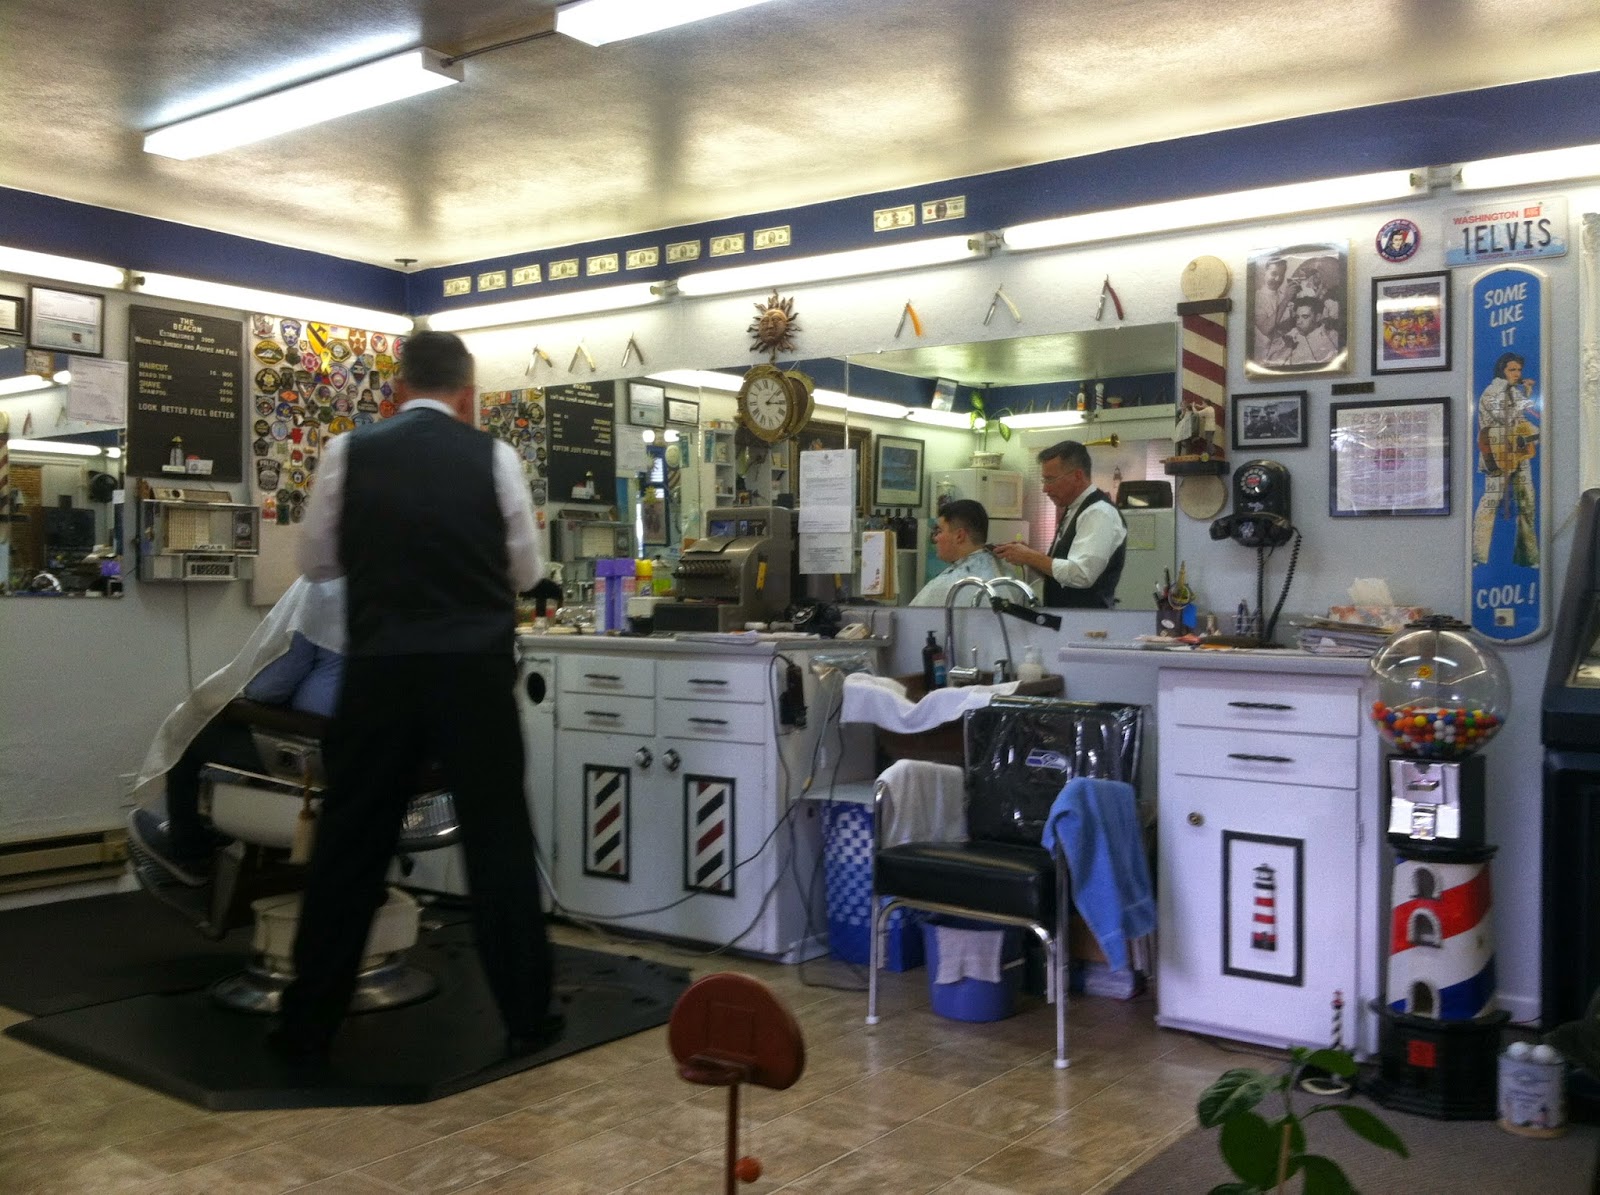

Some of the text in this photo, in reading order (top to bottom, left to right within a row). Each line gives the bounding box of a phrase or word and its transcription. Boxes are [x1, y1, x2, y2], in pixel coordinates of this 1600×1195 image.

[1453, 211, 1518, 225] WASHINGTON
[1462, 218, 1551, 255] 1ELVIS
[1484, 282, 1528, 309] SOME
[180, 317, 195, 325] THE
[1490, 303, 1524, 328] LIKE
[172, 323, 203, 333] BEACON
[1501, 327, 1517, 347] IT
[139, 361, 169, 371] HAIRCUT
[138, 402, 235, 419] LOOK BETTER FEEL BETTER
[1476, 582, 1536, 609] COOL!
